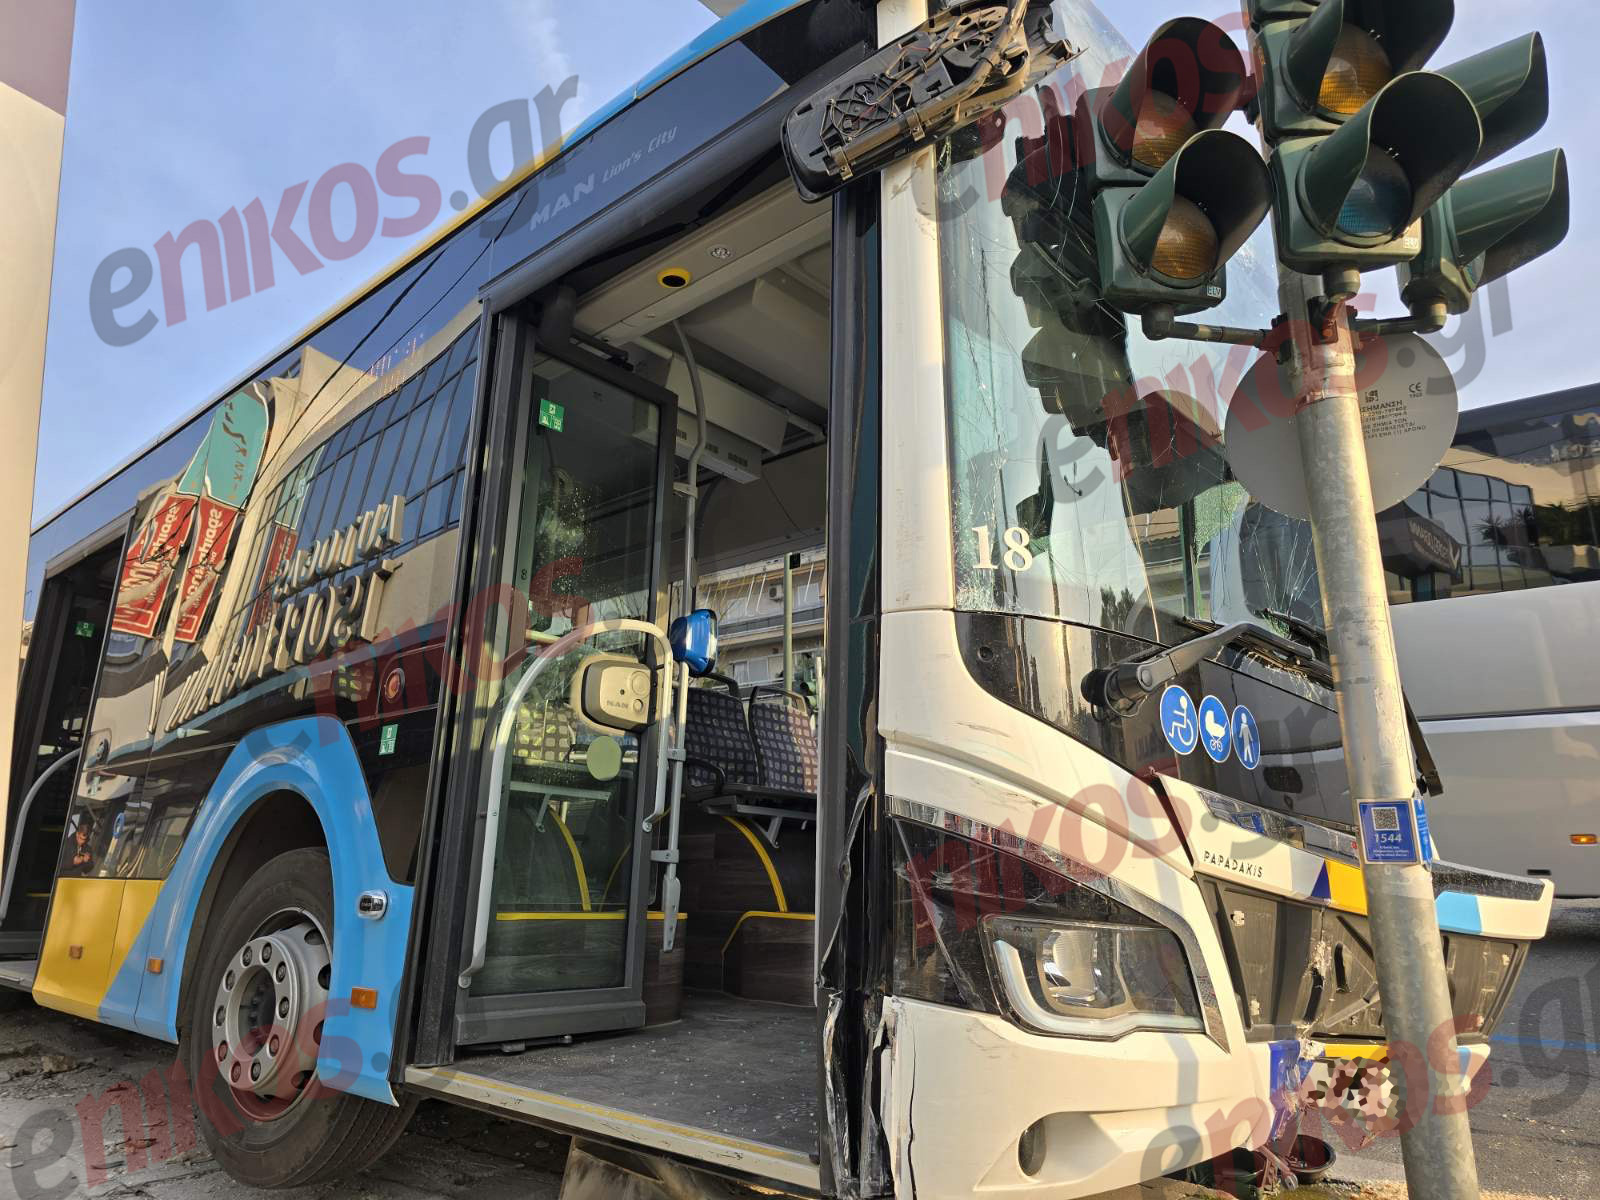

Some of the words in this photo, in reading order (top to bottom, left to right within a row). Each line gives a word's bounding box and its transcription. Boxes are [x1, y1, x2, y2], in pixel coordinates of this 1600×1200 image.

[530, 173, 595, 231] MAN
[602, 149, 643, 184] Lion's
[647, 126, 678, 153] City
[971, 524, 1033, 572] 18
[1374, 833, 1402, 844] 1544
[1203, 850, 1263, 878] PAPADAKIS
